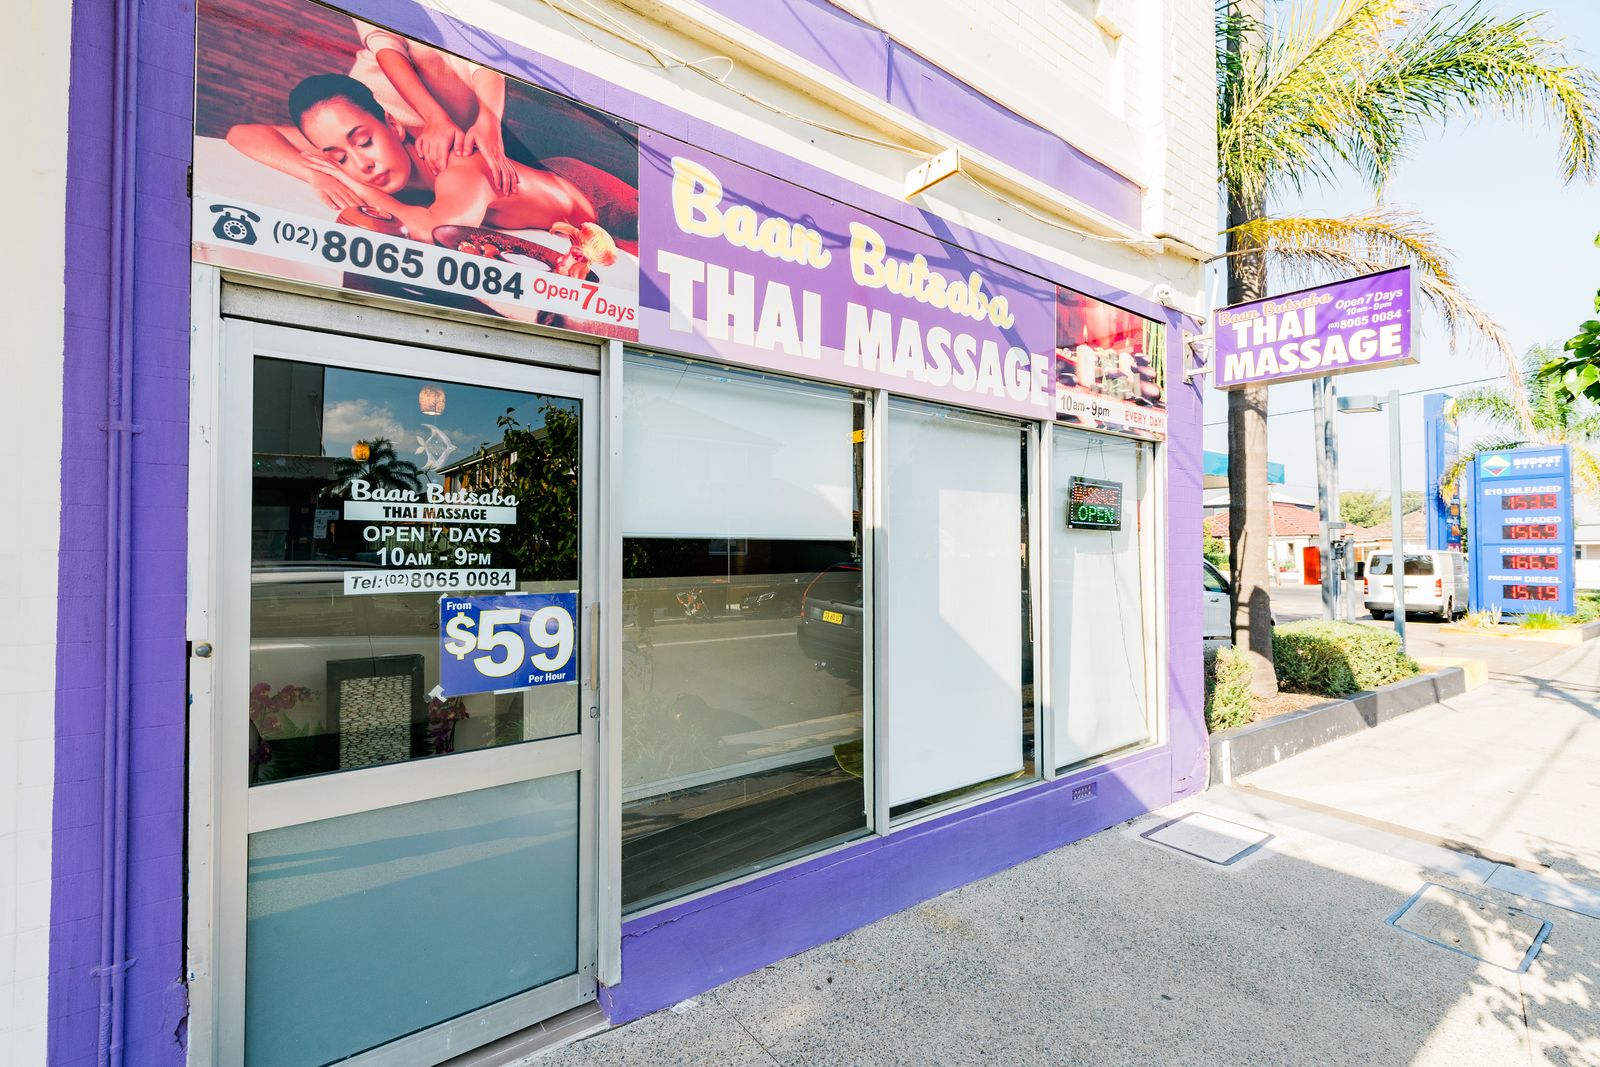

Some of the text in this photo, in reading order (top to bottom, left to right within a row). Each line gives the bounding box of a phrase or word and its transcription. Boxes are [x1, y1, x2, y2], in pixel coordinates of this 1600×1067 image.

[671, 156, 1015, 331] Baan Butsaba
[273, 220, 524, 300] (02) 8065 0084
[533, 277, 635, 322] Open 7 Days
[1335, 289, 1403, 311] Open 7 Days
[1218, 293, 1334, 327] Baan Butsaba
[1340, 315, 1369, 329] 8065
[1372, 309, 1403, 323] 0084
[657, 249, 1050, 408] THAI MASSAGE
[1232, 306, 1316, 349] THAI
[1224, 323, 1402, 382] MASSAGE
[1125, 410, 1147, 425] EVERY
[350, 479, 520, 507] Baan Butsaba
[1484, 485, 1561, 496] E10 UNLEADED
[382, 506, 488, 521] THAI MASSAGE
[1078, 505, 1114, 523] OPEN
[1504, 516, 1562, 524] UNLEADED
[363, 525, 501, 543] OPEN 7 DAYS
[1509, 524, 1558, 539] 156.9
[376, 547, 432, 566] 10AM
[454, 547, 491, 566] 9PM
[1500, 547, 1562, 555] PREMIUM 95
[1510, 555, 1558, 570] 166.9
[351, 570, 511, 590] Tel: (02) 8065 0084
[1524, 576, 1563, 584] DIESEL
[1511, 585, 1559, 601] 151.9
[446, 601, 472, 611] From
[444, 605, 575, 678] $59
[528, 671, 566, 683] Per Hour
